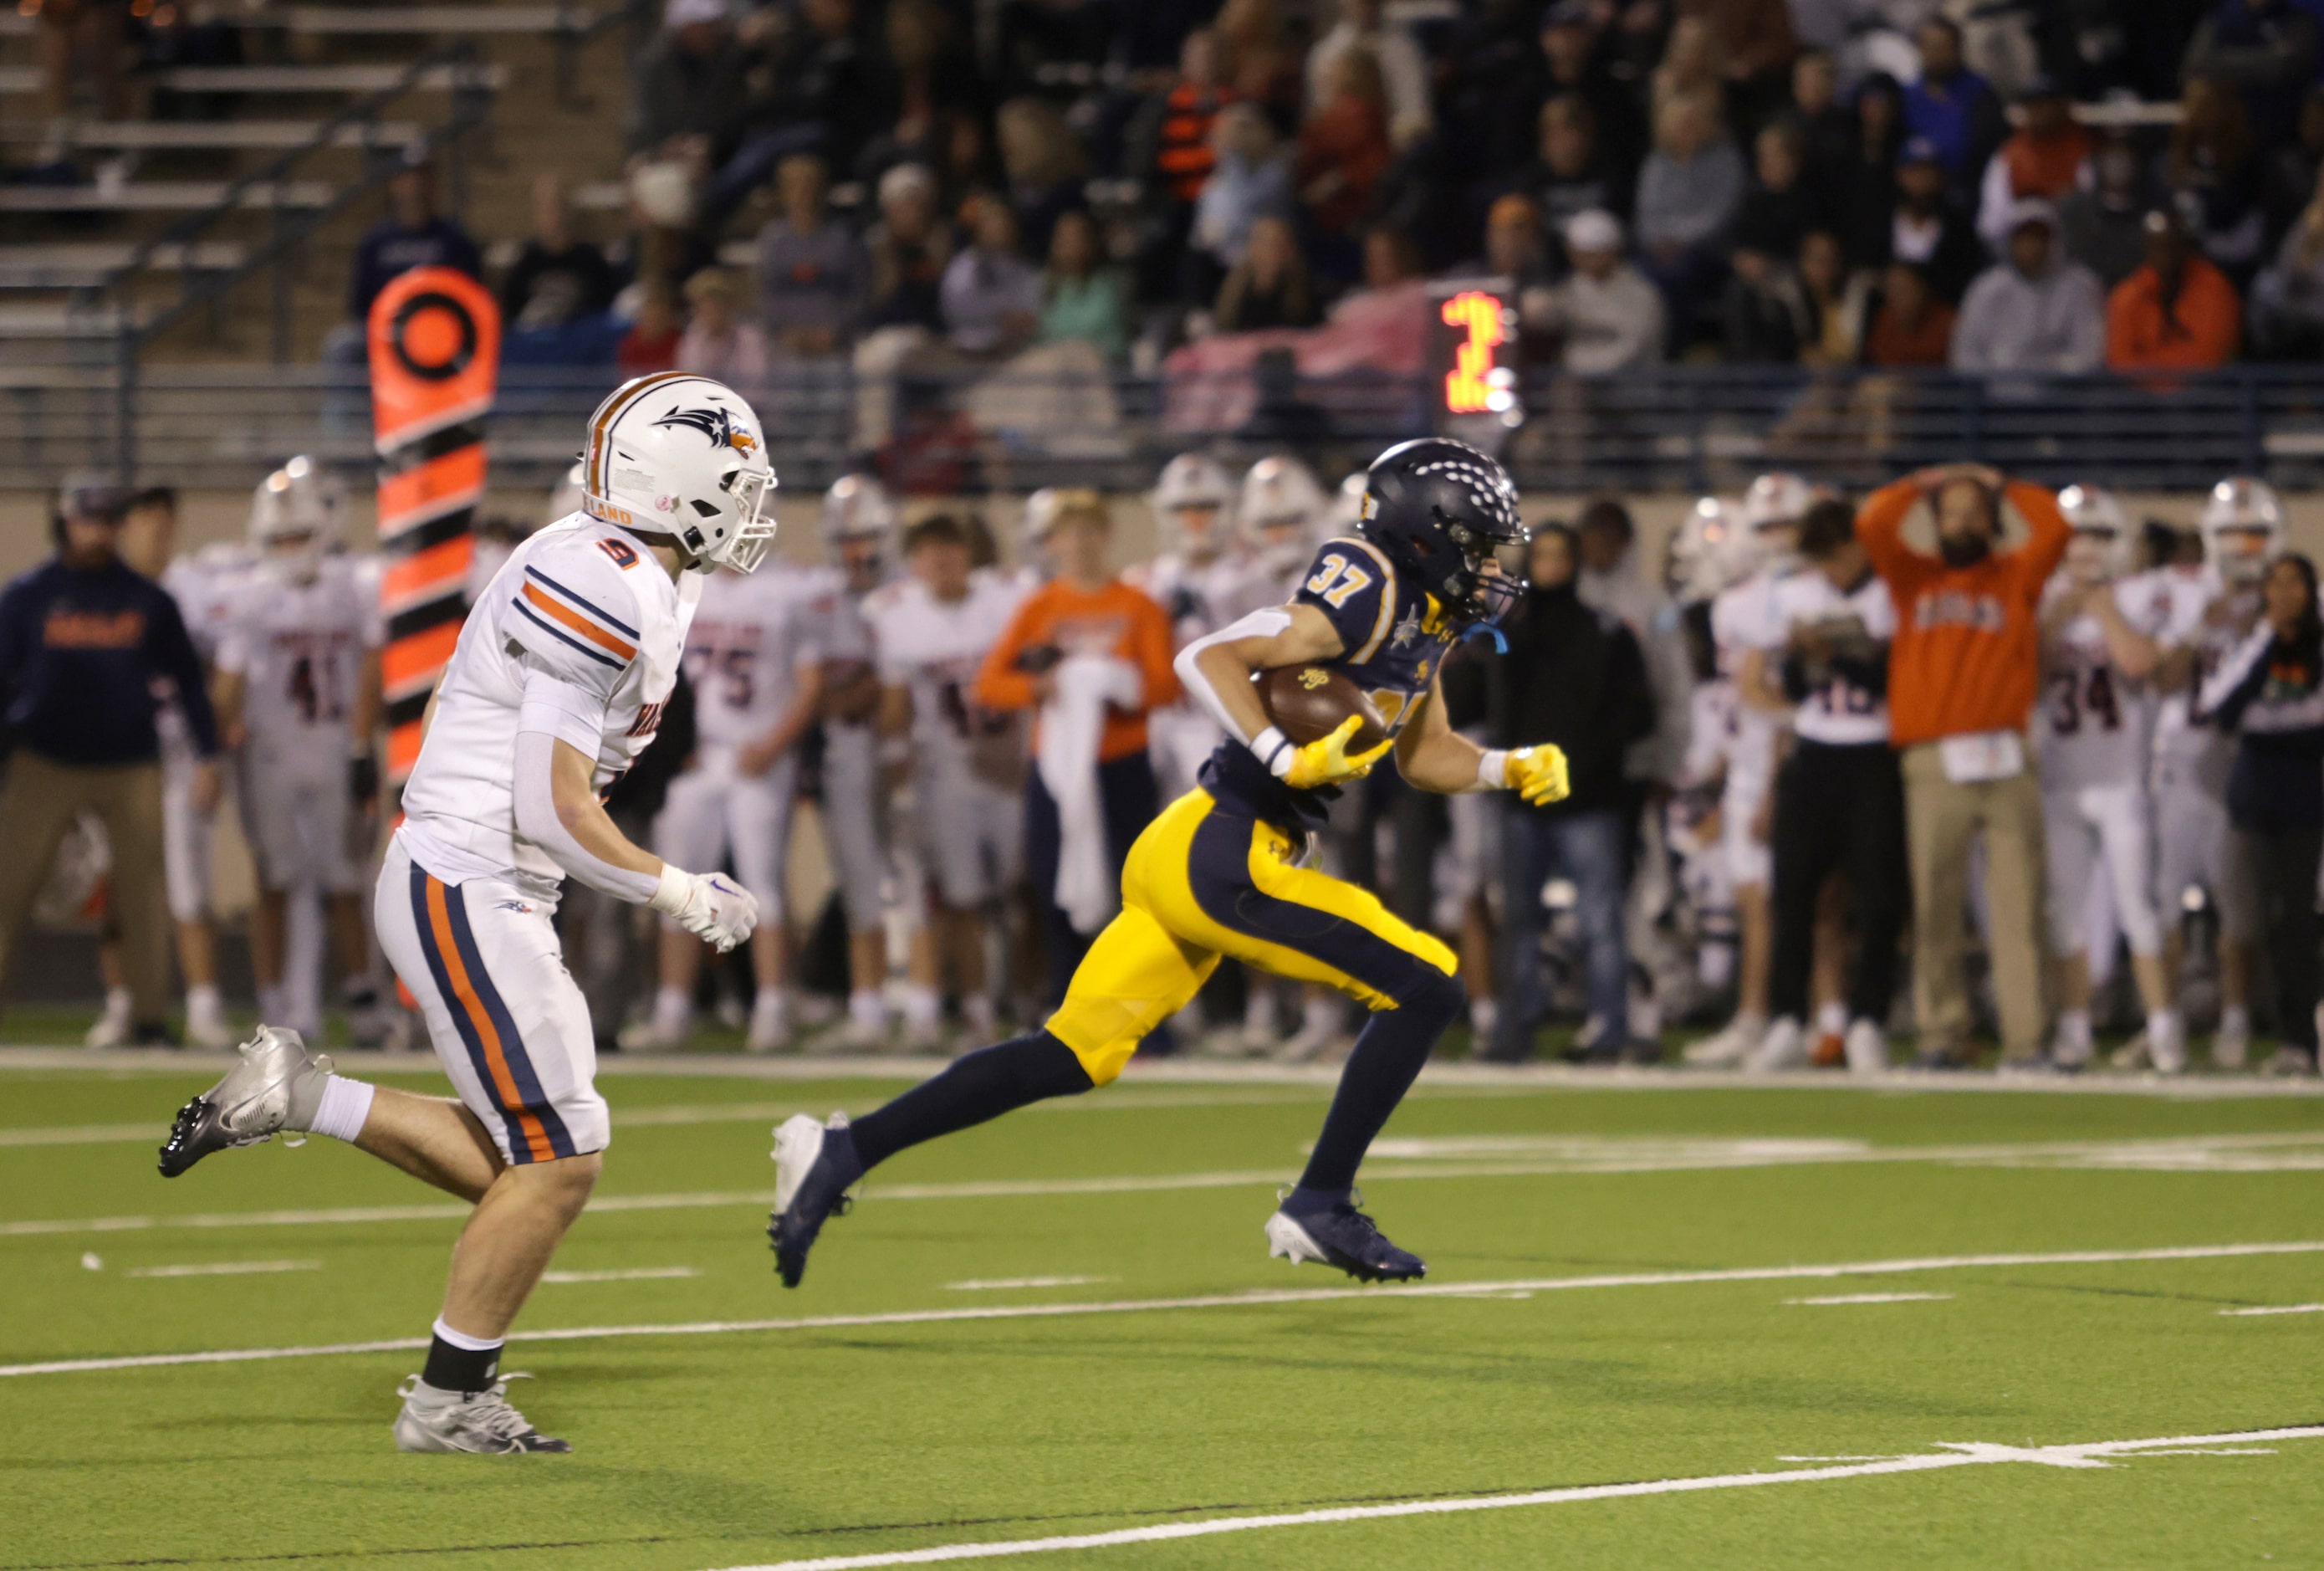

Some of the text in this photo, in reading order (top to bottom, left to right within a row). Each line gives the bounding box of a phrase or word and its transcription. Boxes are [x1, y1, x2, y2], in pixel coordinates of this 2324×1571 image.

[1442, 291, 1509, 412] 2
[1306, 553, 1372, 610] 37
[2047, 665, 2122, 733] 34
